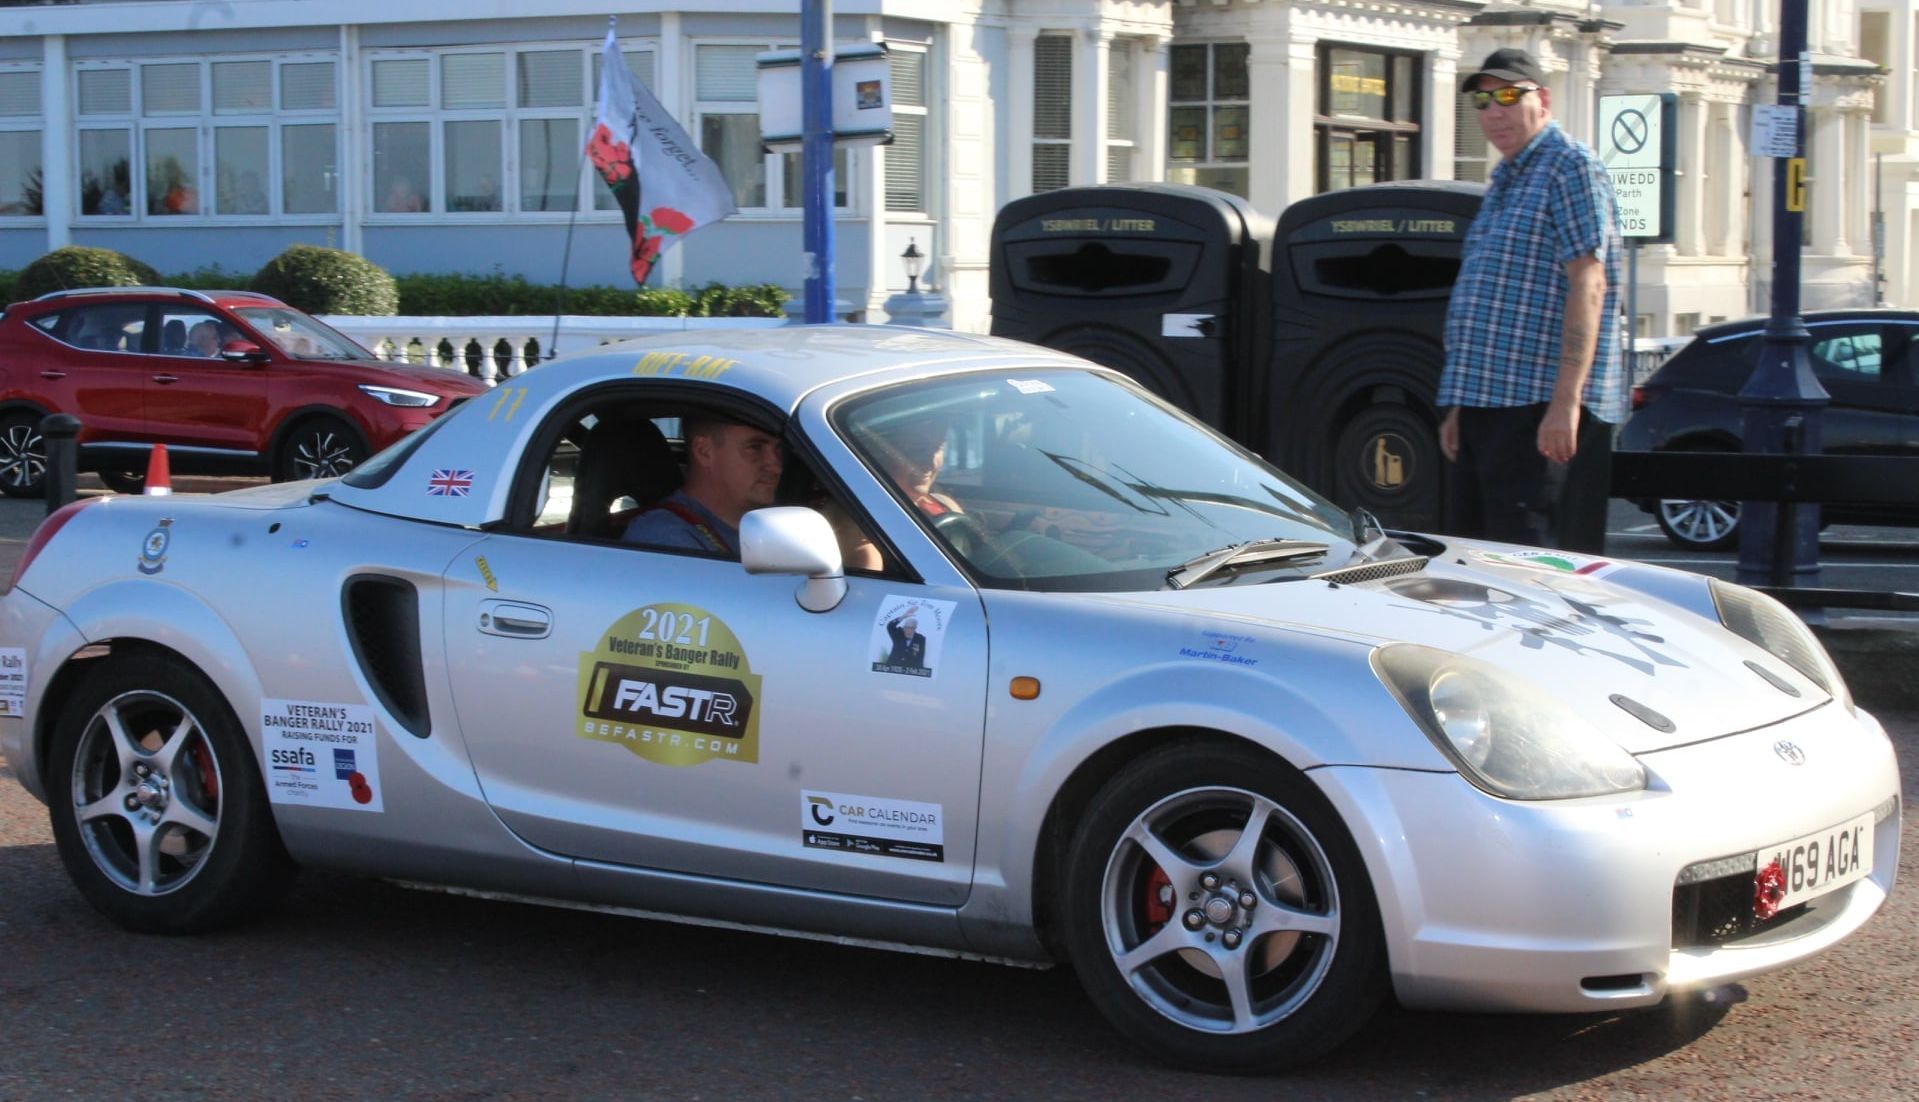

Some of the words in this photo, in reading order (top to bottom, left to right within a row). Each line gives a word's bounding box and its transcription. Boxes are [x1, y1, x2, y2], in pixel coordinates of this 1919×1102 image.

[1612, 173, 1656, 185] IWEDD
[1616, 189, 1642, 198] Parth
[1617, 207, 1640, 216] Zone
[1111, 219, 1155, 231] LITTER
[1330, 219, 1395, 232] YSBWRIEL
[1408, 220, 1455, 232] LITTER
[1619, 219, 1647, 230] NDS
[638, 607, 712, 647] 2021
[609, 635, 664, 658] Veteran's
[665, 643, 709, 665] Banger
[710, 650, 740, 670] Rally
[1179, 647, 1258, 666] Martin-Baker
[613, 678, 738, 726] FASTR
[287, 704, 347, 720] VETERAN'S
[264, 714, 309, 729] BANGER
[311, 718, 344, 732] RALLY
[346, 721, 373, 734] 2021
[282, 730, 313, 741] RAISING
[314, 732, 340, 743] FUNDS
[342, 735, 358, 744] FOR
[584, 721, 738, 754] BEFASTR.COM
[272, 747, 315, 766] ssafa
[839, 804, 865, 817] CAR
[868, 807, 936, 825] CALENDAR
[1825, 826, 1860, 882] AGA
